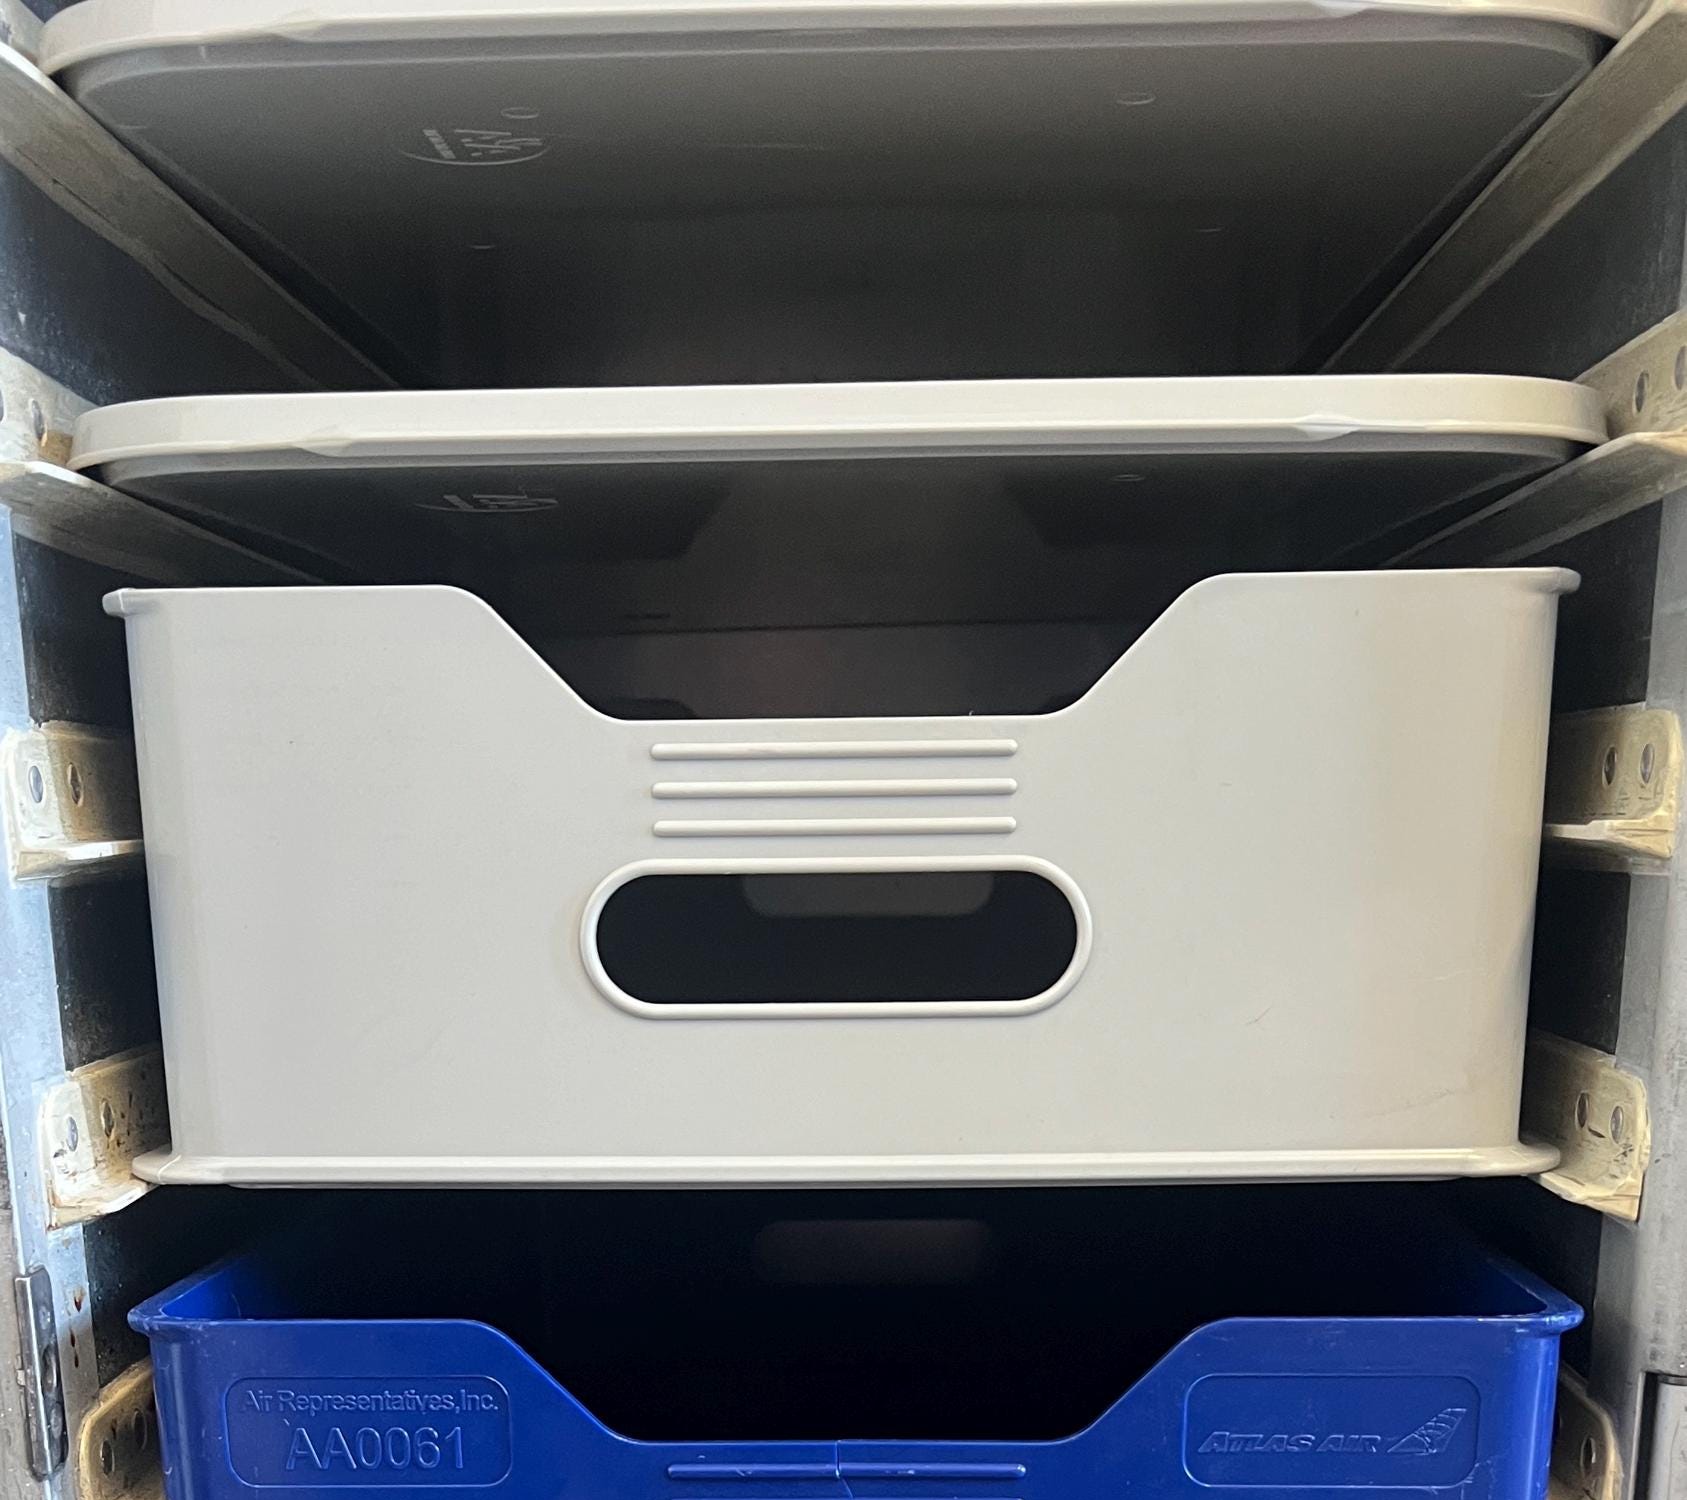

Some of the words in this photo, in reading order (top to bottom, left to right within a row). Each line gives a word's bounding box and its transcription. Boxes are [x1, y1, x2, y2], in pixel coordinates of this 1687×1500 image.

[243, 1390, 273, 1412] Air
[285, 1426, 464, 1470] AA0061
[1198, 1431, 1316, 1453] ATLAS
[1316, 1434, 1382, 1453] AIR
